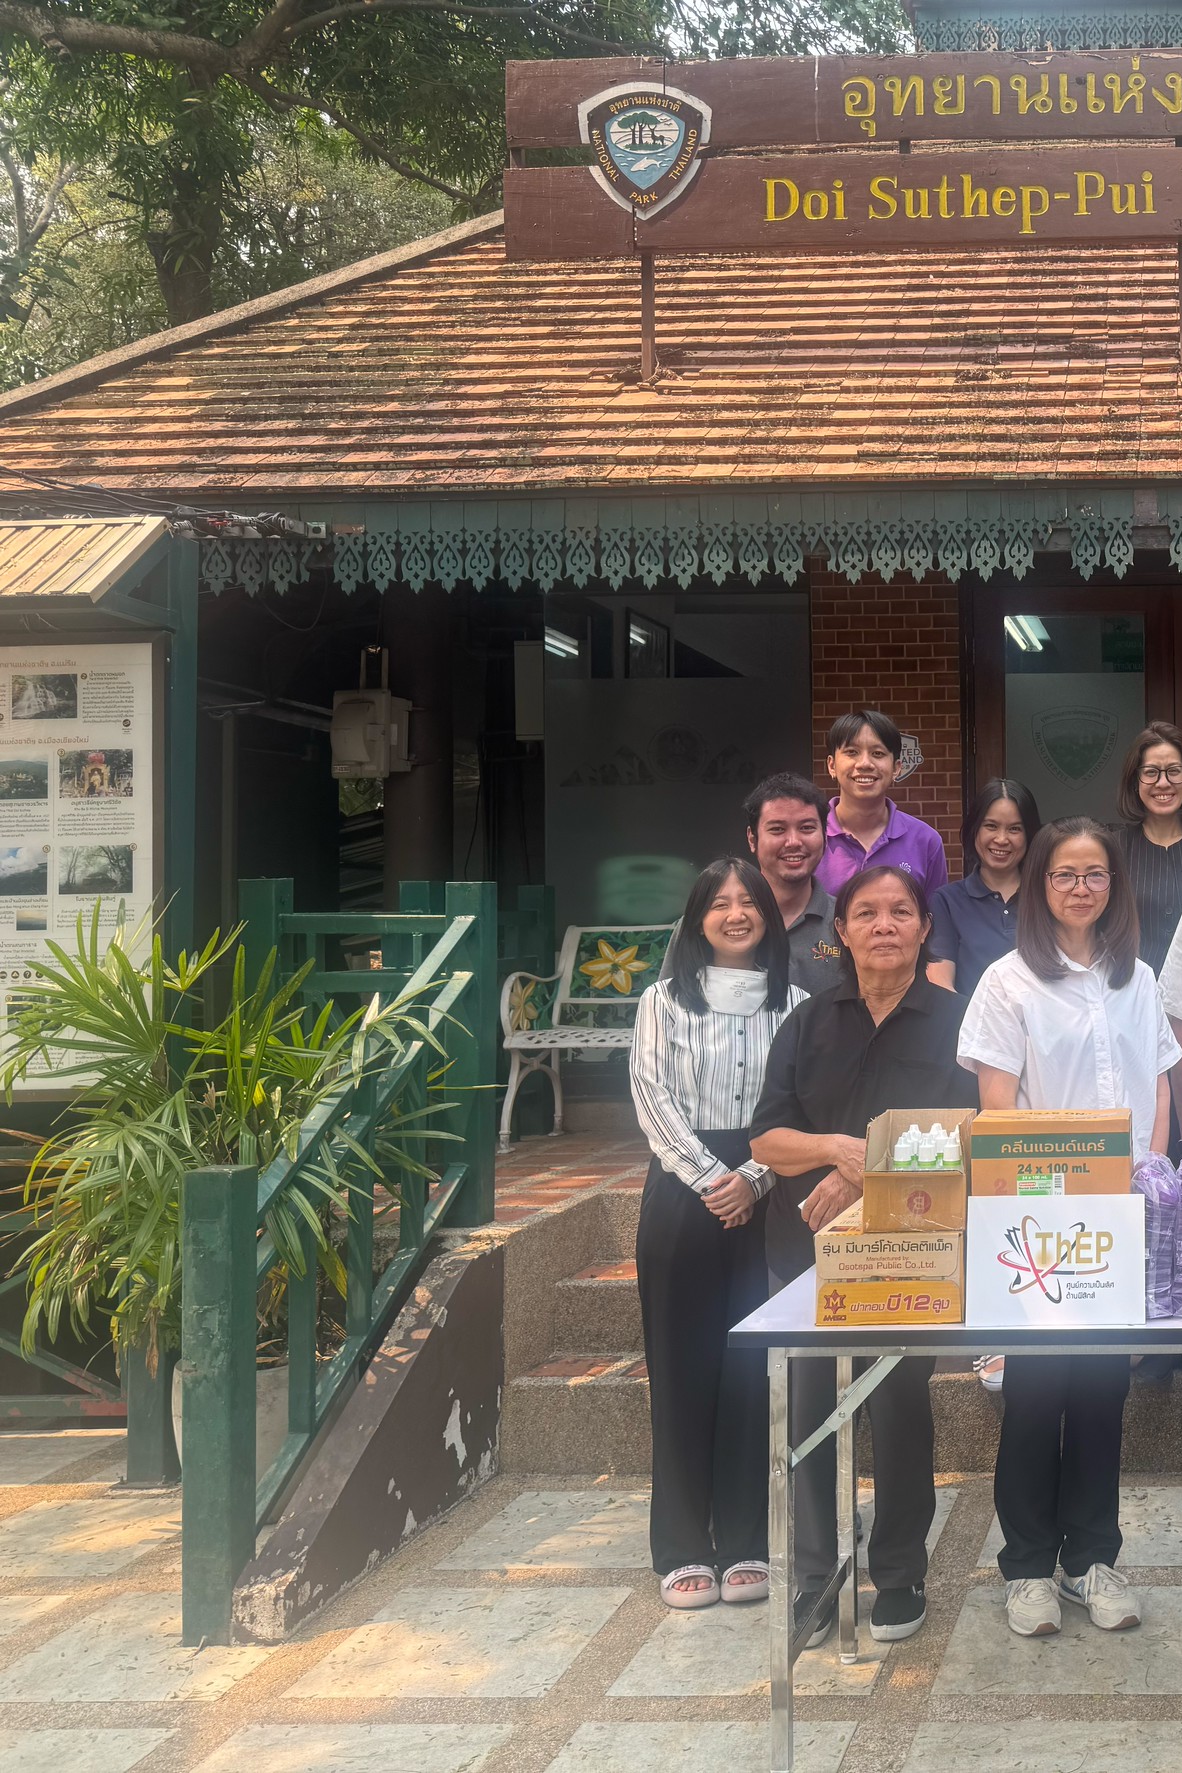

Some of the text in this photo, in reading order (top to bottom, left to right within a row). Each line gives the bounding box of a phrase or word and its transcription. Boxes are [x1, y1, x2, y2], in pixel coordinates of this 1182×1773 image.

[592, 129, 619, 183] NATIONAL
[668, 129, 698, 180] THAILAND
[629, 191, 659, 205] PARK
[763, 177, 847, 222] Doi
[868, 170, 1157, 235] Suthep-Pui
[1001, 1139, 1106, 1153] คลีนแอนด์แคร์
[1017, 1164, 1032, 1174] 24
[1036, 1166, 1042, 1174] x
[1046, 1163, 1068, 1174] 100
[822, 1243, 840, 1257] รุ่น
[1035, 1232, 1114, 1264] ThEP
[876, 1261, 902, 1270] Public
